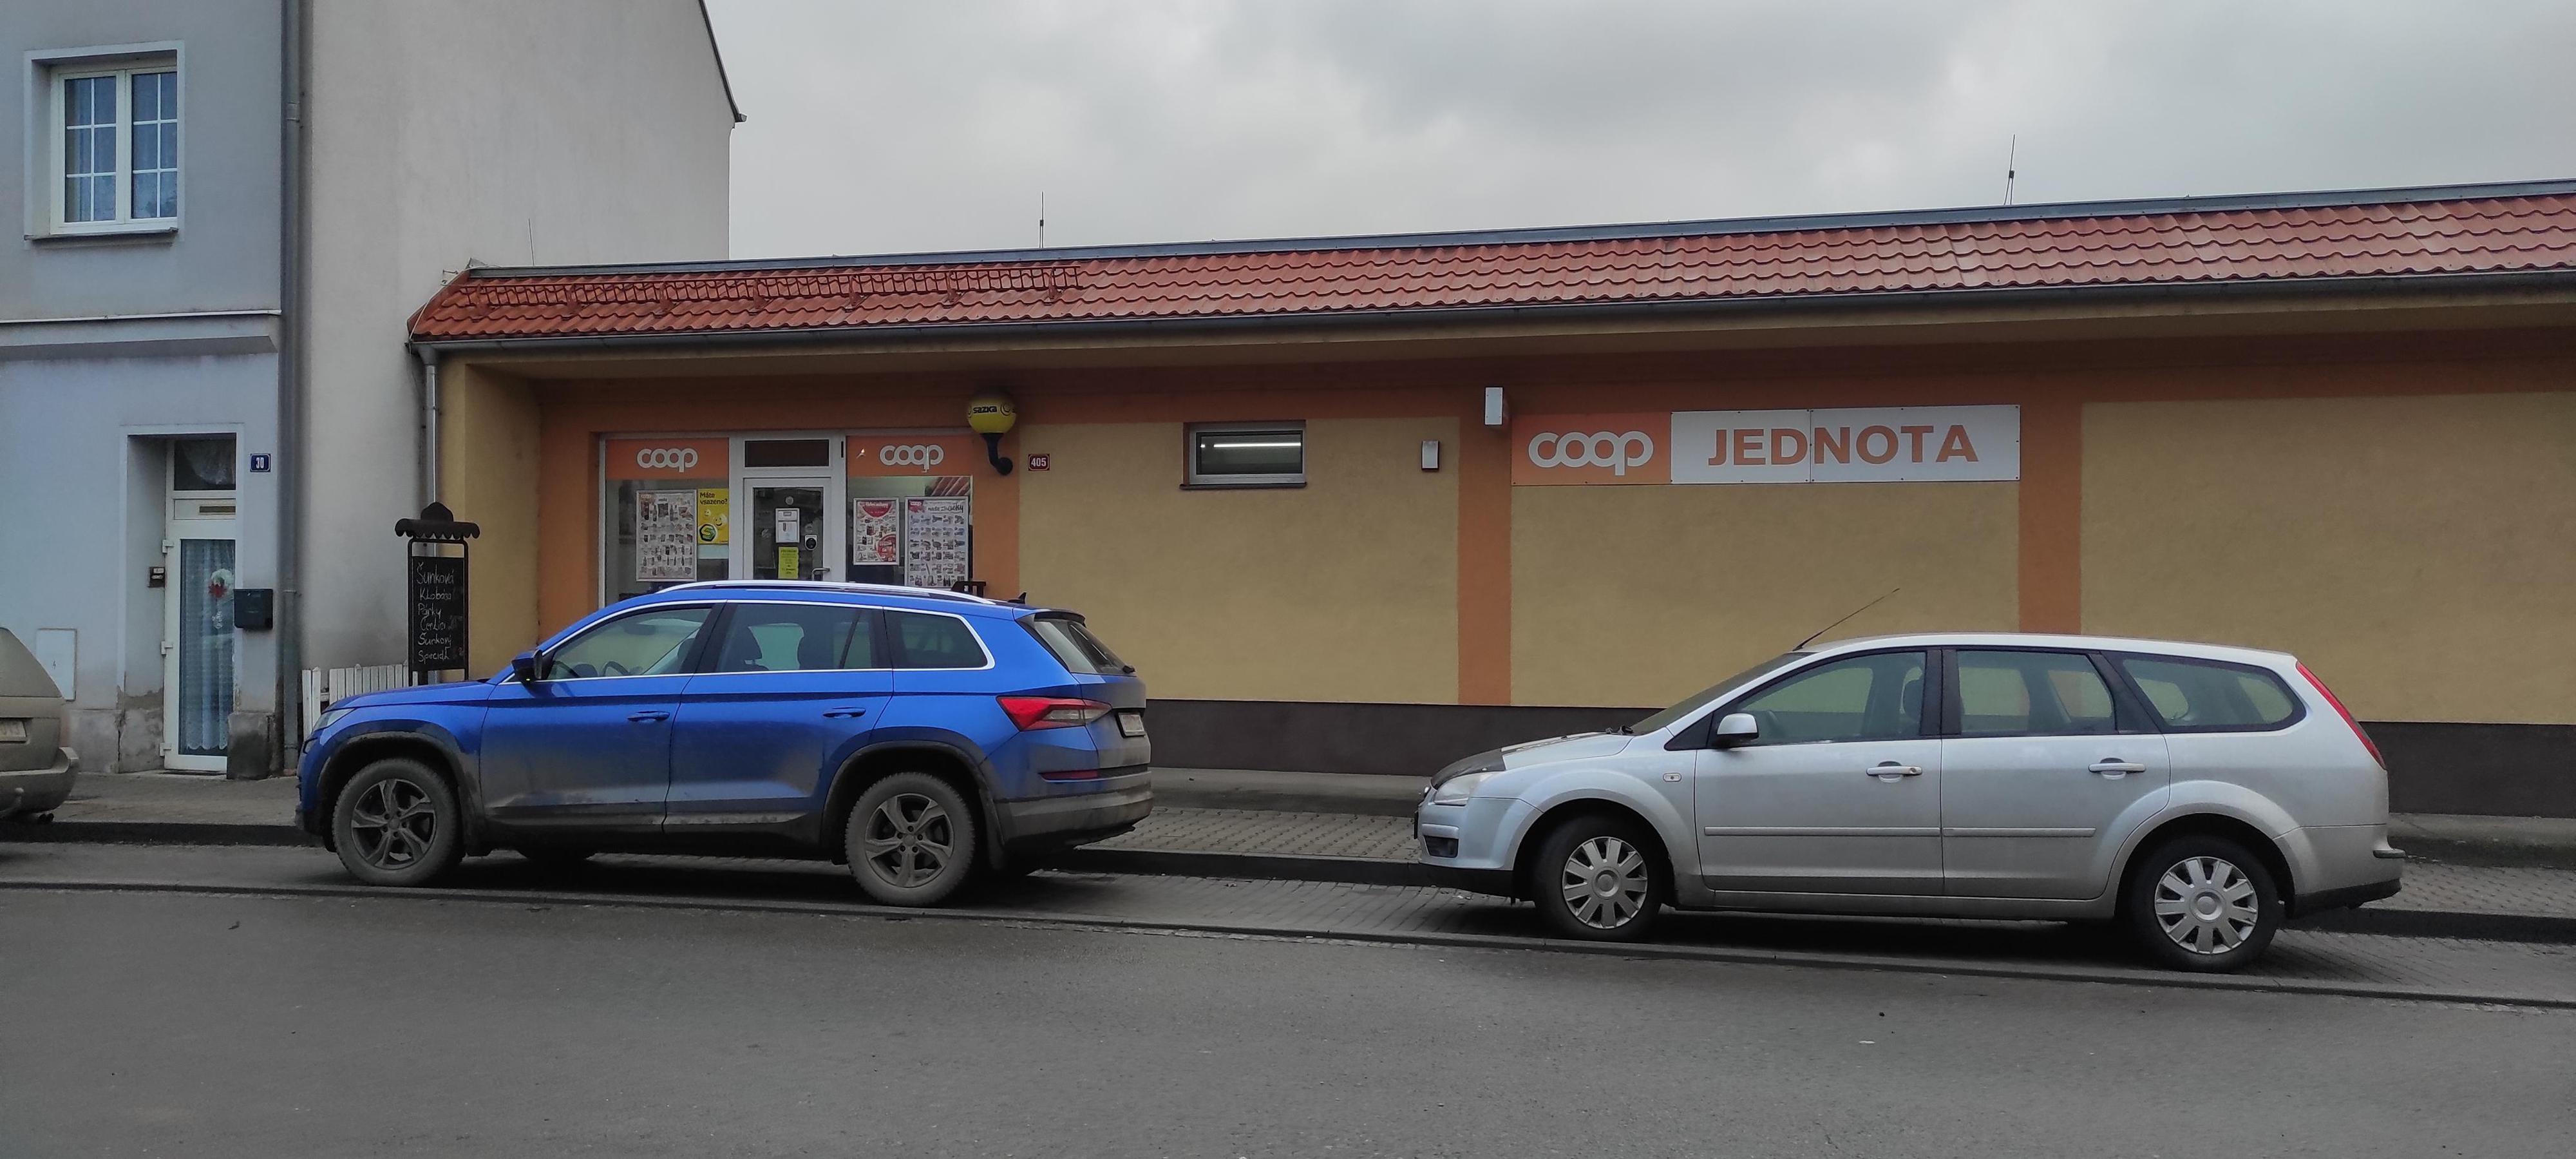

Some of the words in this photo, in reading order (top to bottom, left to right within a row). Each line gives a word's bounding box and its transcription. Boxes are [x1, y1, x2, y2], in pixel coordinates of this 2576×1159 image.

[1528, 431, 1654, 475] coop
[1708, 424, 1979, 466] JEDNOTA
[256, 457, 264, 469] 30
[637, 448, 698, 472] coop
[879, 445, 944, 472] coop
[1031, 457, 1046, 467] 405
